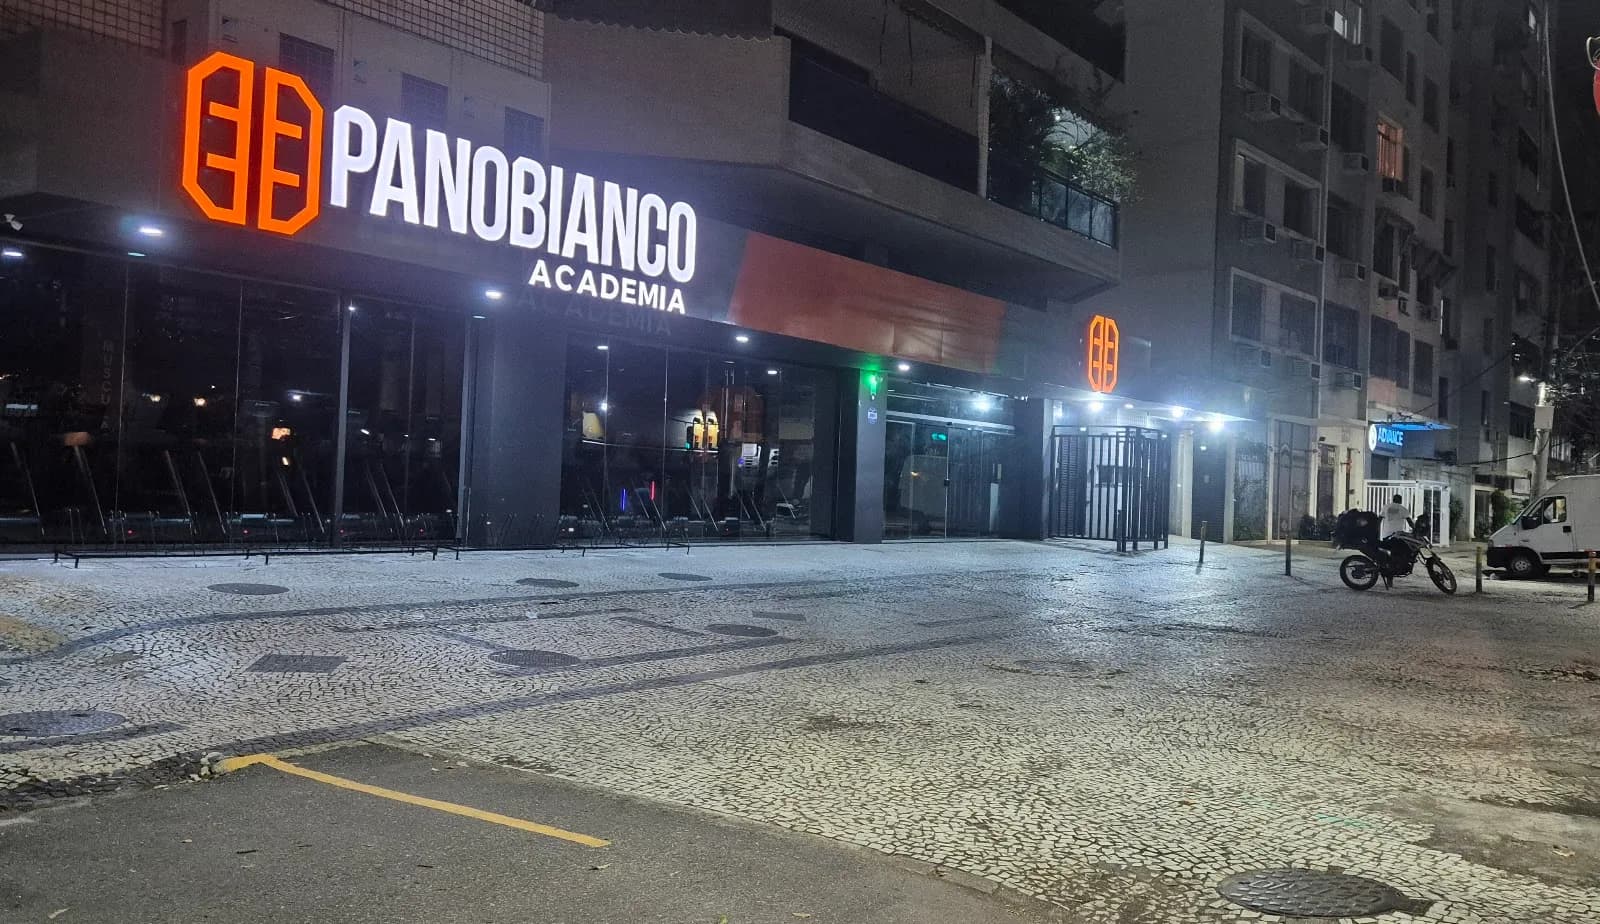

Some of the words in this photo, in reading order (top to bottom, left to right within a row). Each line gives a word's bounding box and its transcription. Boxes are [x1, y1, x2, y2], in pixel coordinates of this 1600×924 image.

[330, 104, 697, 283] PANOBIANCO
[528, 259, 686, 315] ACADEMIA
[1377, 427, 1404, 447] ADVANCE
